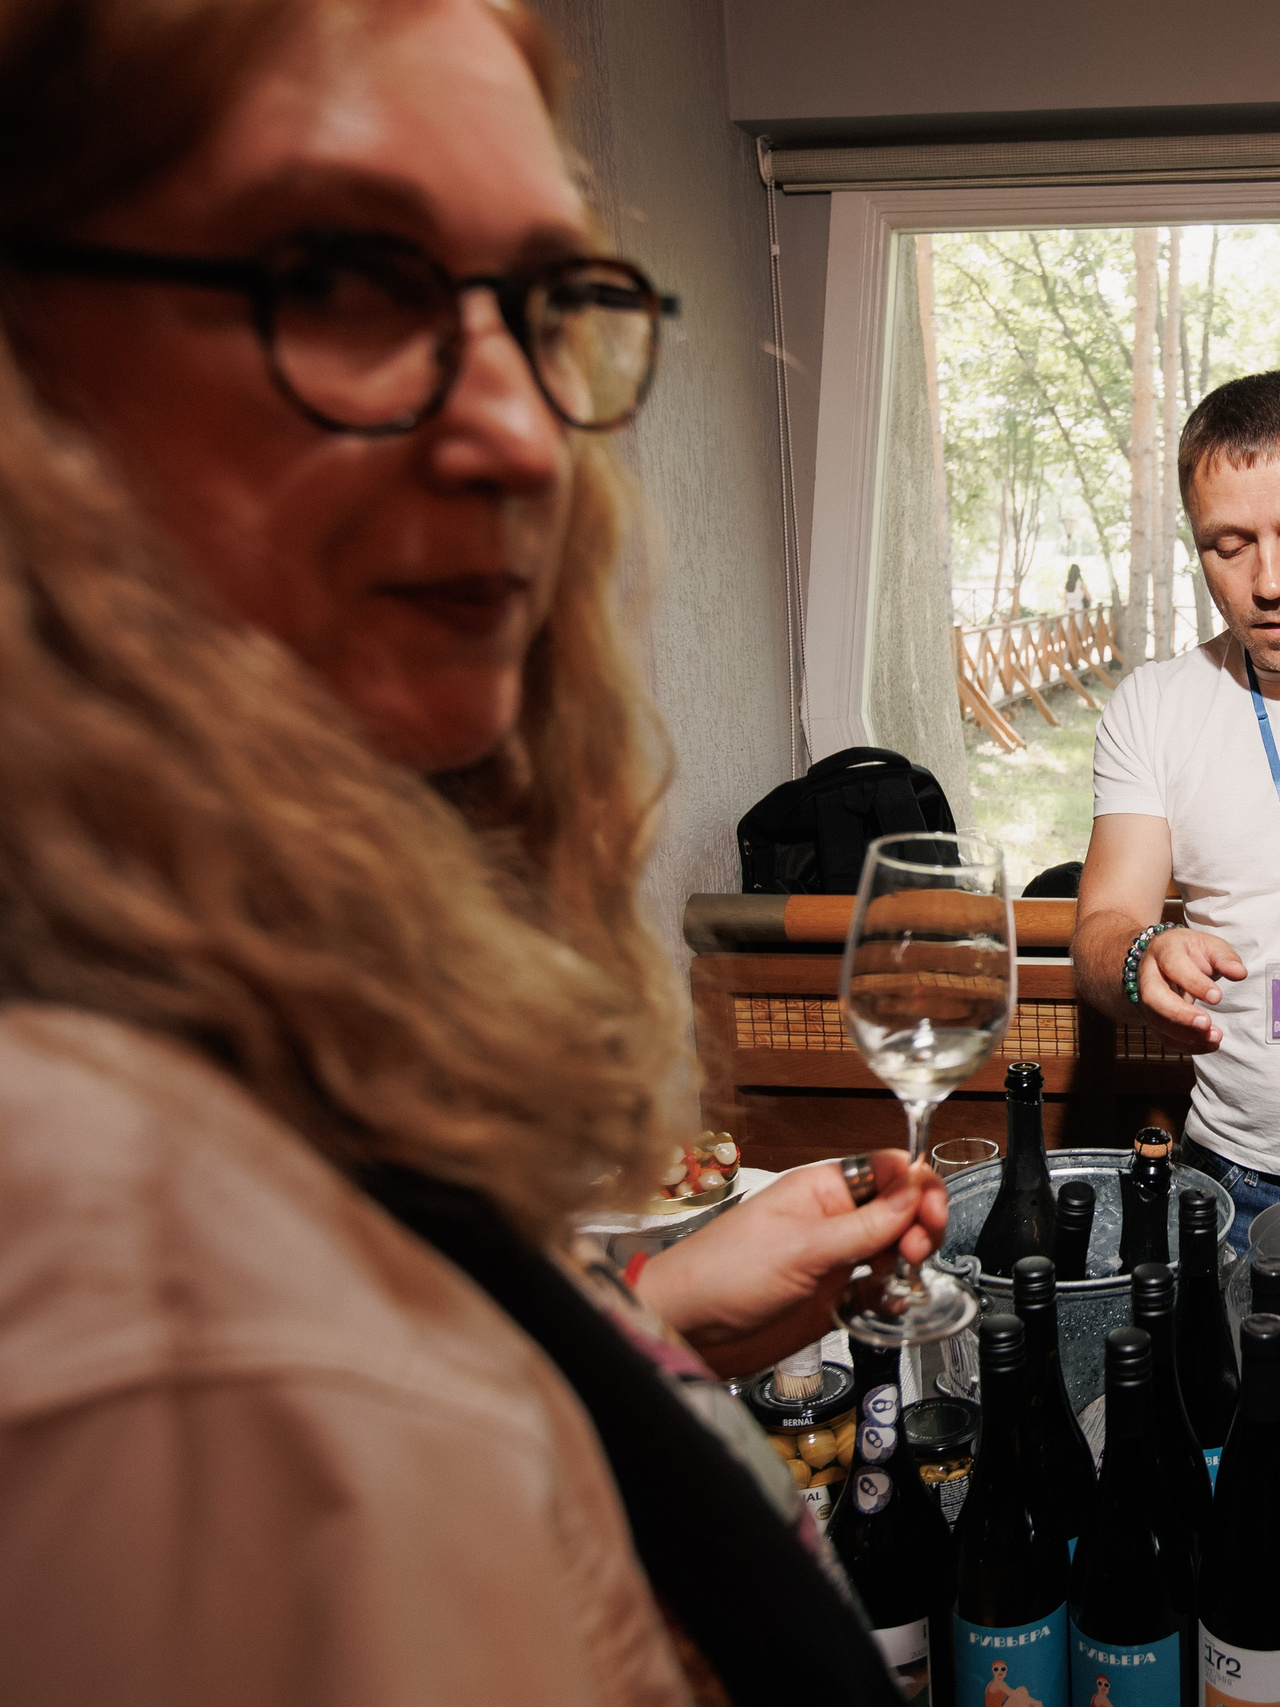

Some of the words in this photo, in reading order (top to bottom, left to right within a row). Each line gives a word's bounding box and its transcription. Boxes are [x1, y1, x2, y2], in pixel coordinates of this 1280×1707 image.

[783, 1417, 815, 1427] BERNAL
[970, 1626, 1051, 1647] РИВЬЕРА
[1079, 1640, 1157, 1666] РИВЬЕРА
[1205, 1643, 1241, 1679] 172
